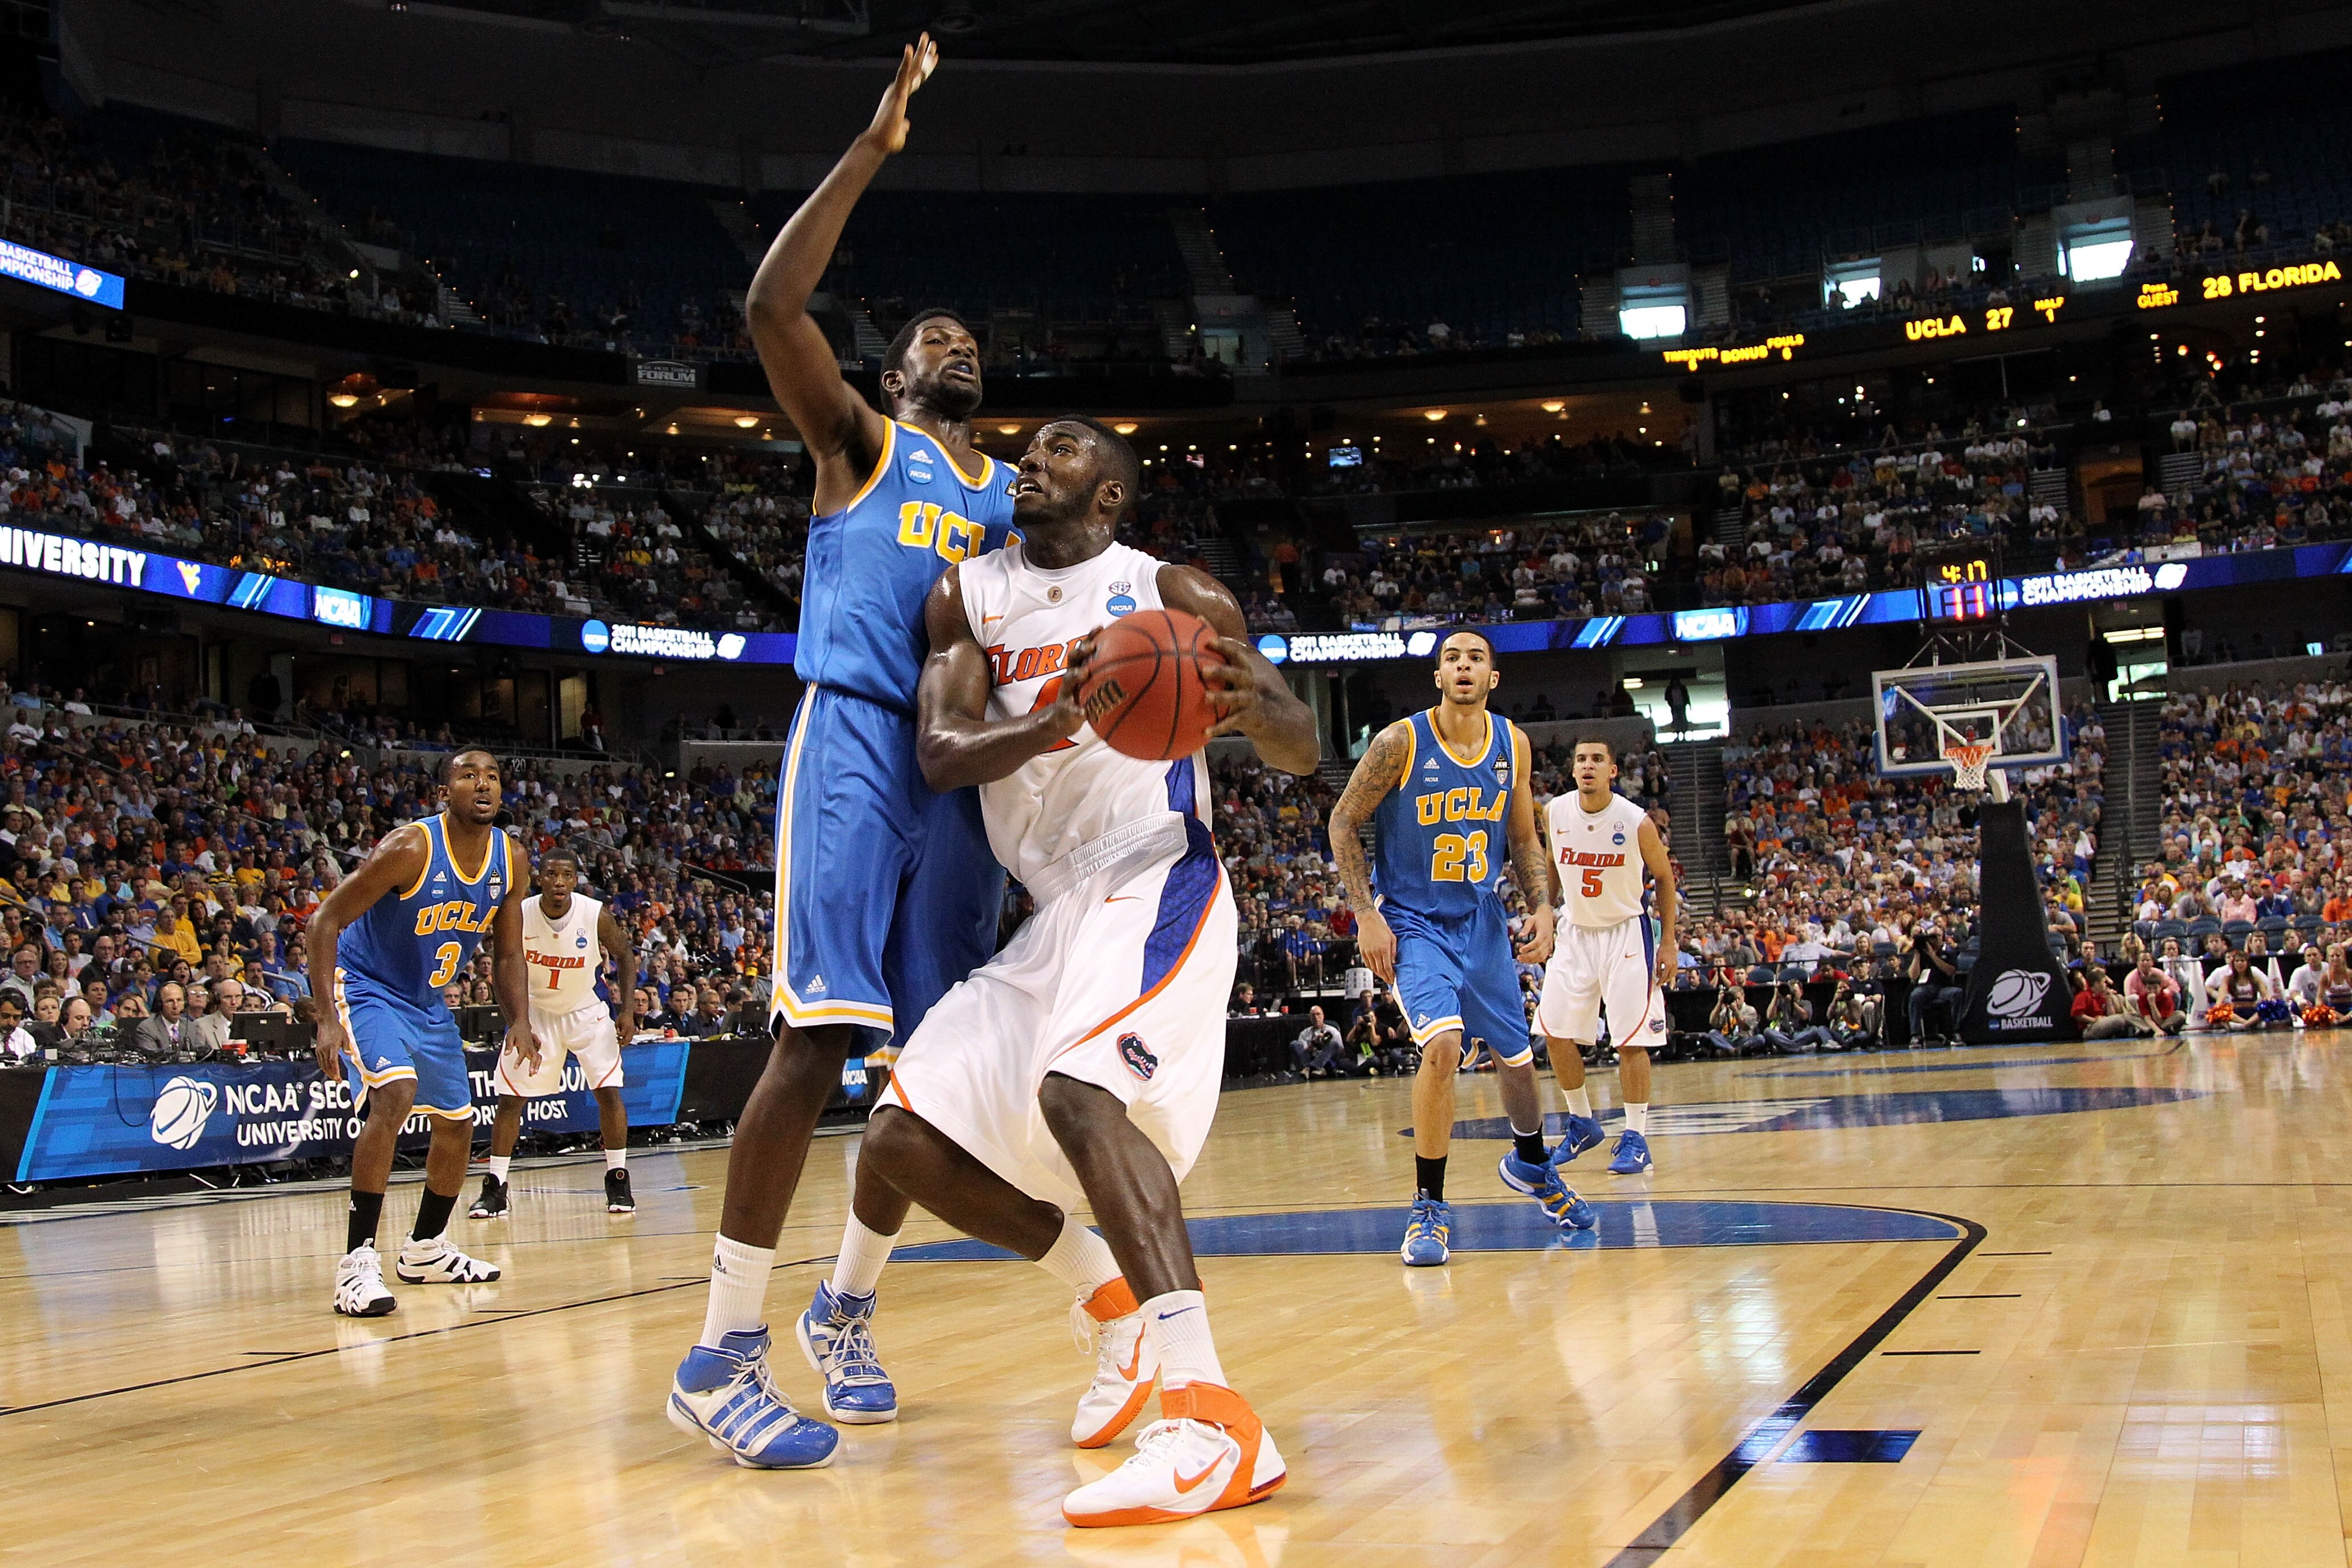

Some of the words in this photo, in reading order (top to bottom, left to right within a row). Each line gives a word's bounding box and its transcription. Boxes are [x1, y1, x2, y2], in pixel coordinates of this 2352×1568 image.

[0, 241, 73, 277] BASKETBALL
[2203, 276, 2232, 299] 28
[2238, 261, 2342, 293] FLORIDA
[2137, 290, 2179, 309] GUEST
[1906, 315, 1966, 340] UCLA
[1986, 307, 2013, 330] 27
[2046, 309, 2054, 322] 1
[1767, 334, 1804, 349] FOULS
[1663, 347, 1719, 363] TIMEOUTS
[1720, 345, 1768, 363] BONUS
[638, 370, 696, 382] FORUM
[910, 470, 931, 480] NCAA
[898, 500, 1021, 565] UCL
[1942, 560, 1987, 584] 4:17
[2022, 576, 2052, 592] 2011
[2054, 565, 2150, 588] BASKETBALL
[1110, 582, 1129, 595] SEC
[2022, 577, 2153, 605] CHAMPIONSHIP
[314, 594, 361, 628] NCAA
[612, 624, 636, 638] 2011
[637, 627, 713, 645] BASKETBALL
[1676, 613, 1736, 638] NCAA
[611, 637, 716, 658] CHAMPIONSHIP
[1290, 636, 1317, 649] 2011
[1319, 632, 1404, 647] BASKETBALL
[1290, 643, 1406, 662] CHAMPIONSHIP
[511, 758, 526, 771] 120
[1431, 830, 1489, 883] 23
[1559, 847, 1625, 867] FLORIDA
[1582, 868, 1605, 897] 5
[429, 941, 462, 988] 3
[525, 949, 585, 968] FLORIDA
[546, 969, 560, 990] 1
[2001, 1016, 2054, 1030] BASKETBALL
[842, 1069, 867, 1086] NCAA
[309, 1081, 352, 1110] SEC
[237, 1118, 342, 1146] UNIVERSITY
[346, 1117, 365, 1139] O
[528, 1100, 569, 1121] HOST
